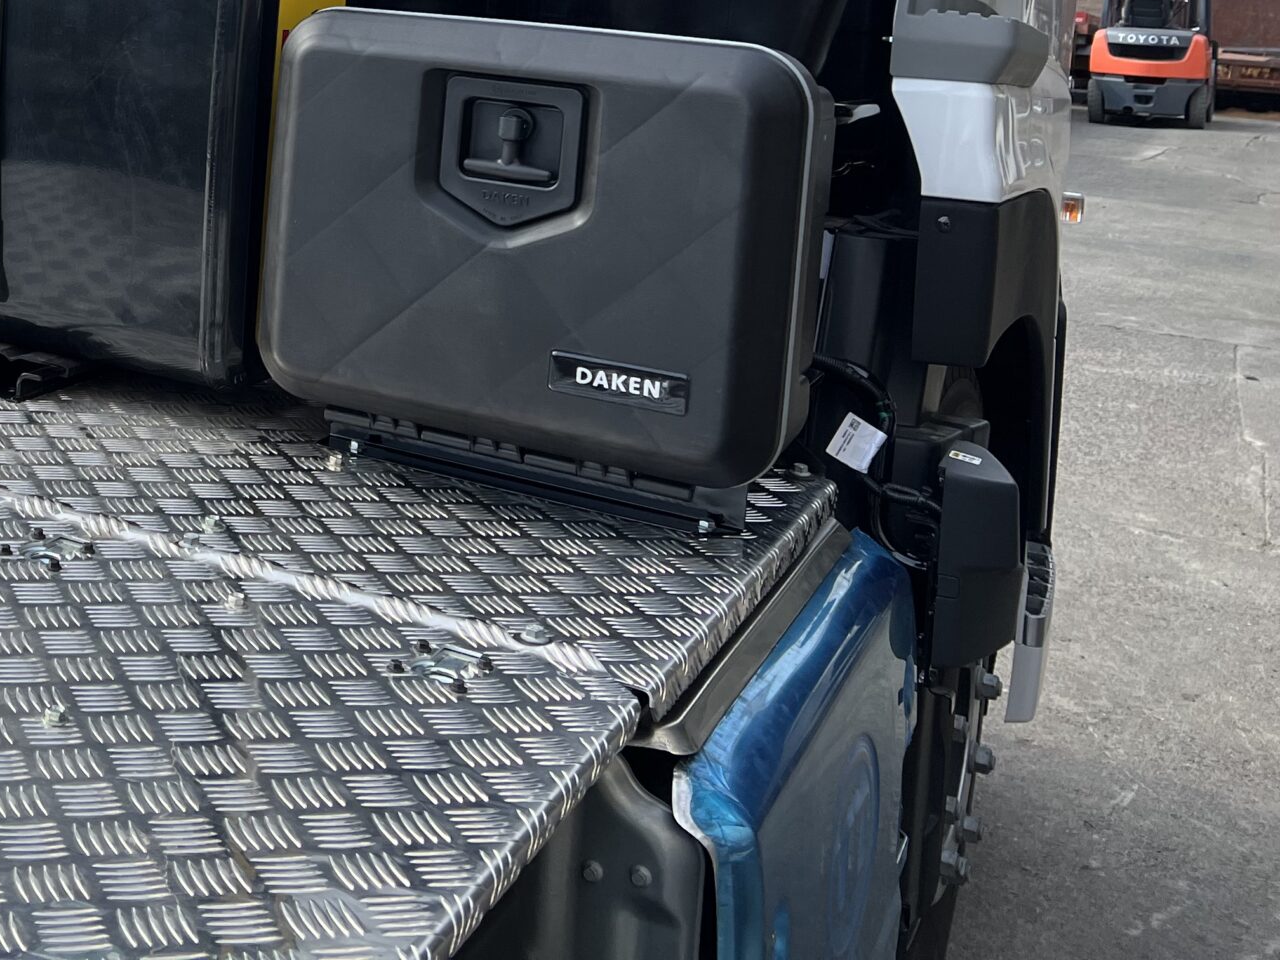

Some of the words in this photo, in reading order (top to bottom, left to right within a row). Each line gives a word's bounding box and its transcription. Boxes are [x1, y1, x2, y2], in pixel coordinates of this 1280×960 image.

[1118, 33, 1180, 45] TOYOTA
[481, 189, 530, 208] DAKEN
[575, 366, 661, 399] DAKEN
